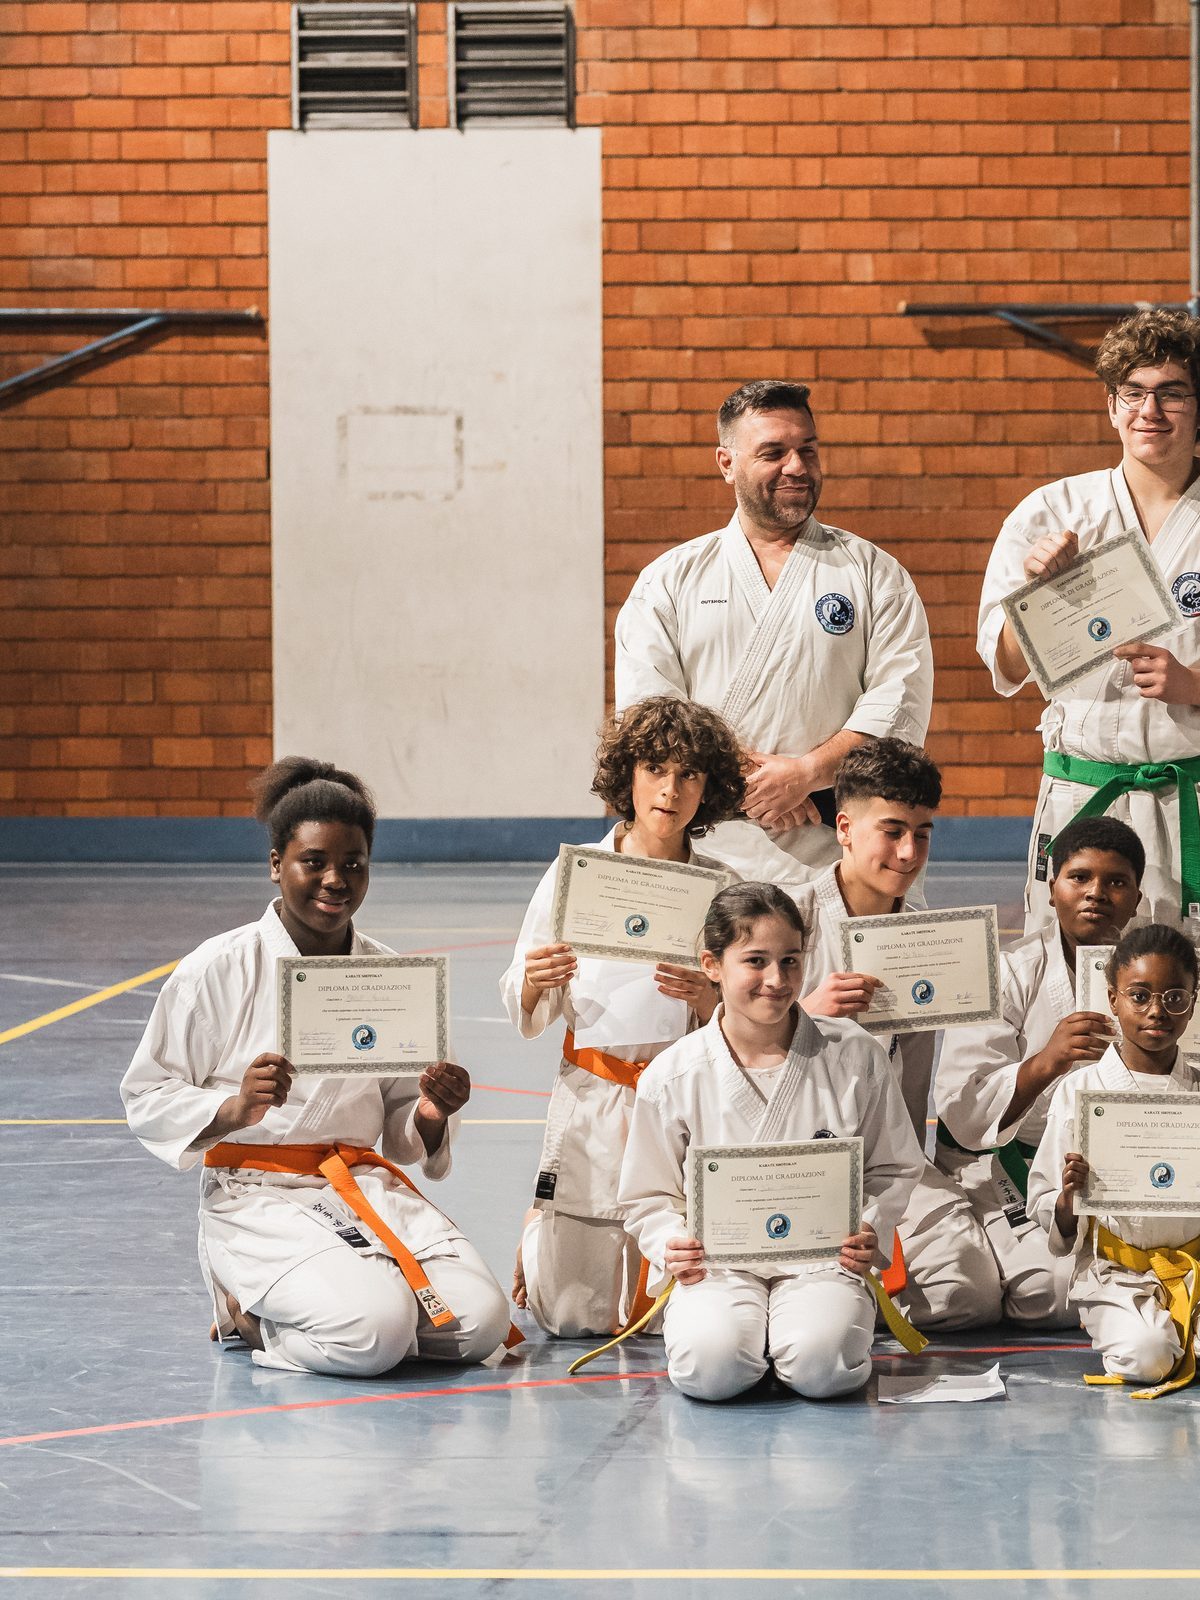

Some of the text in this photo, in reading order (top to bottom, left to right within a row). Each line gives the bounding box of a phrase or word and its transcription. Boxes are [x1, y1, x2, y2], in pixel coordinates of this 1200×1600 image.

[1040, 593, 1067, 612] DIPLOMA
[1067, 588, 1076, 597] DI
[597, 874, 629, 884] DIPLOMA
[876, 943, 907, 951] DIPLOMA
[731, 1174, 764, 1182] DIPLOMA
